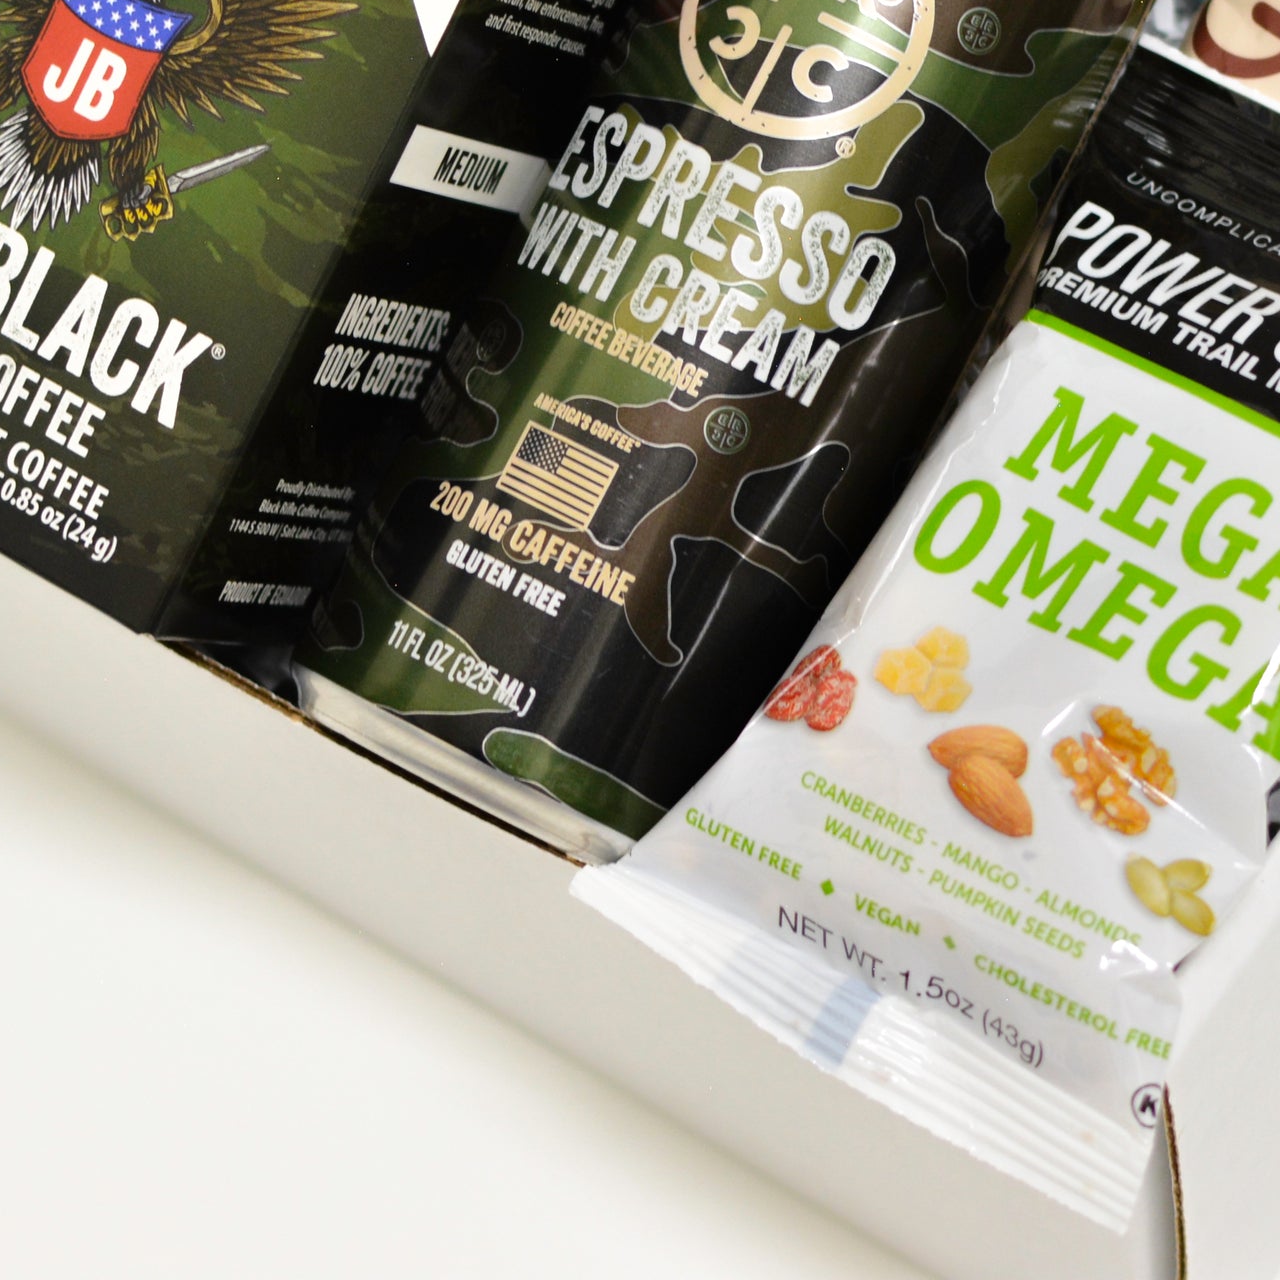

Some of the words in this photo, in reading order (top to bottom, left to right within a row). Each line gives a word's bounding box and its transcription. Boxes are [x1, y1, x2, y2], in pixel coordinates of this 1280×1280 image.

[484, 13, 507, 31] and
[502, 14, 523, 37] first
[519, 22, 562, 49] responder
[42, 37, 128, 123] JB
[432, 146, 509, 196] MEDIUM
[548, 104, 897, 332] ESPRESSO
[334, 292, 452, 353] INGREDIENTS:
[517, 201, 637, 303] WITH
[629, 253, 841, 409] CREAM
[312, 342, 371, 392] 100%
[360, 351, 433, 402] COFFEE
[549, 301, 614, 350] COFFEE
[607, 325, 710, 399] BEVERAGE
[1171, 321, 1262, 381] TRAIL
[533, 391, 594, 433] AMERICA'S
[0, 477, 45, 517] 0.85
[40, 505, 66, 532] oz
[6, 440, 110, 521] COFFEE
[429, 480, 473, 522] 200
[468, 497, 514, 543] MG
[508, 519, 637, 608] CAFFEINE
[445, 538, 516, 592] GLUTEN
[512, 569, 567, 618] FREE
[218, 579, 265, 605] PRODUCT
[386, 619, 405, 648] 11
[400, 626, 424, 662] FL
[424, 637, 455, 674] OZ
[684, 806, 757, 858] GLUTEN
[757, 844, 805, 882] FREE
[800, 769, 928, 847] CRANBERRIES
[940, 840, 1021, 892] MANGO
[823, 813, 915, 875] WALNUTS
[927, 867, 1023, 928] PUMPKIN
[1021, 915, 1088, 961] SEEDS
[853, 891, 921, 937] VEGAN
[777, 904, 835, 950] NET
[841, 935, 887, 983] WT.
[898, 969, 975, 1021] 1.5oz
[981, 1007, 1045, 1070] (43g)
[972, 952, 1120, 1041] CHOLESTEROL
[1123, 1027, 1174, 1062] FREE
